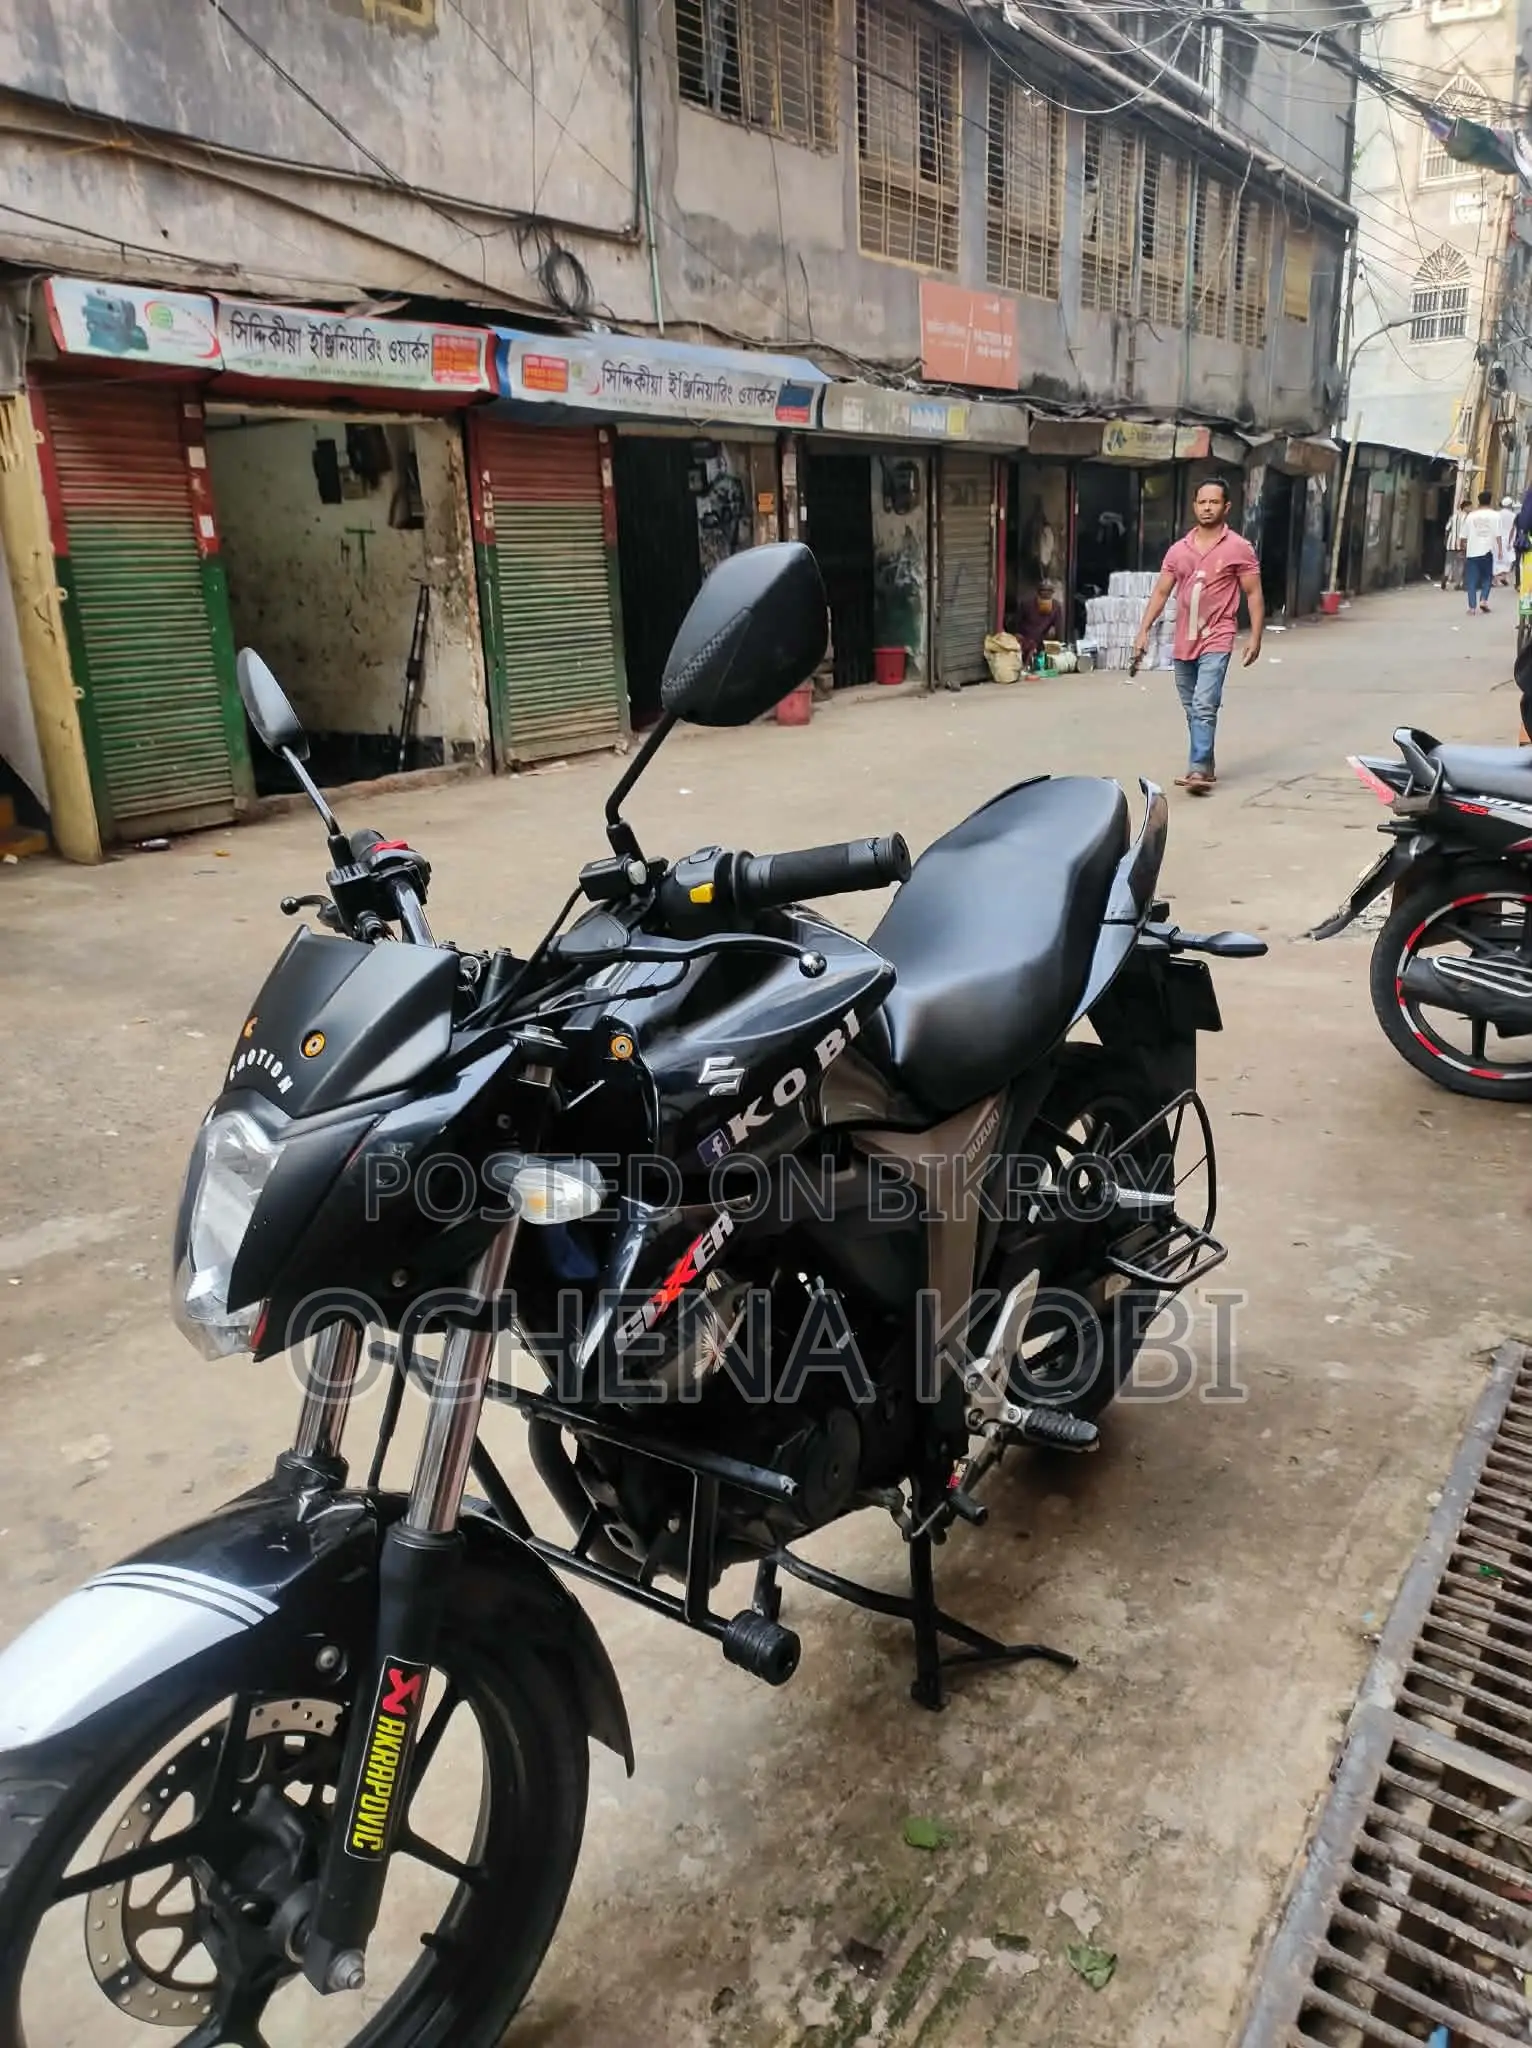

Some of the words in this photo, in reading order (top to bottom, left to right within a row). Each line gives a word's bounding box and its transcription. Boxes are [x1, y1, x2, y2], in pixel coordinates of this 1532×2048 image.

[728, 1008, 860, 1145] KOBI
[967, 1108, 1000, 1163] SUZUKI
[614, 1210, 734, 1355] GIXXER
